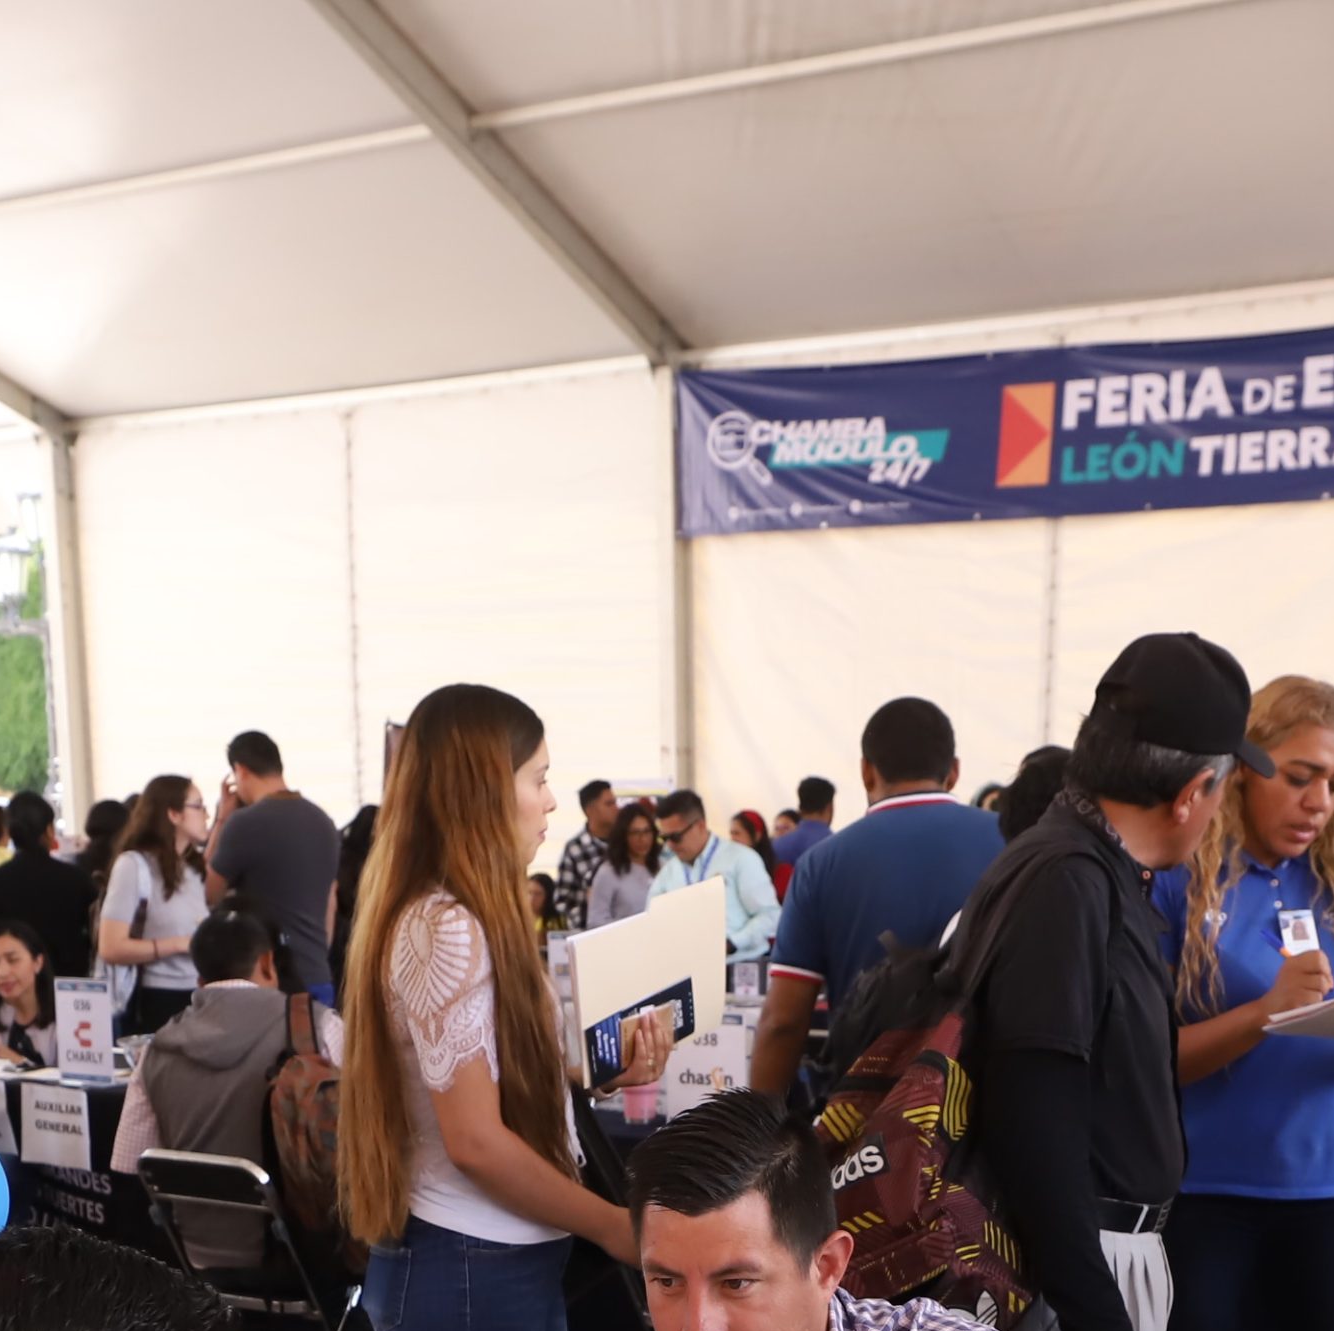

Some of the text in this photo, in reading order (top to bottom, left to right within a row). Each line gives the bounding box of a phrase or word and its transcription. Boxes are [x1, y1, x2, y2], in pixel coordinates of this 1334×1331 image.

[1062, 367, 1234, 430] FERIA
[1242, 375, 1296, 414] DE
[749, 416, 886, 445] CHAMBA
[1060, 430, 1187, 484] LEÓN
[868, 456, 932, 488] 24/7
[66, 1049, 103, 1064] CHARLY
[35, 1101, 82, 1115] AUXILIAR
[35, 1119, 83, 1135] GENERAL
